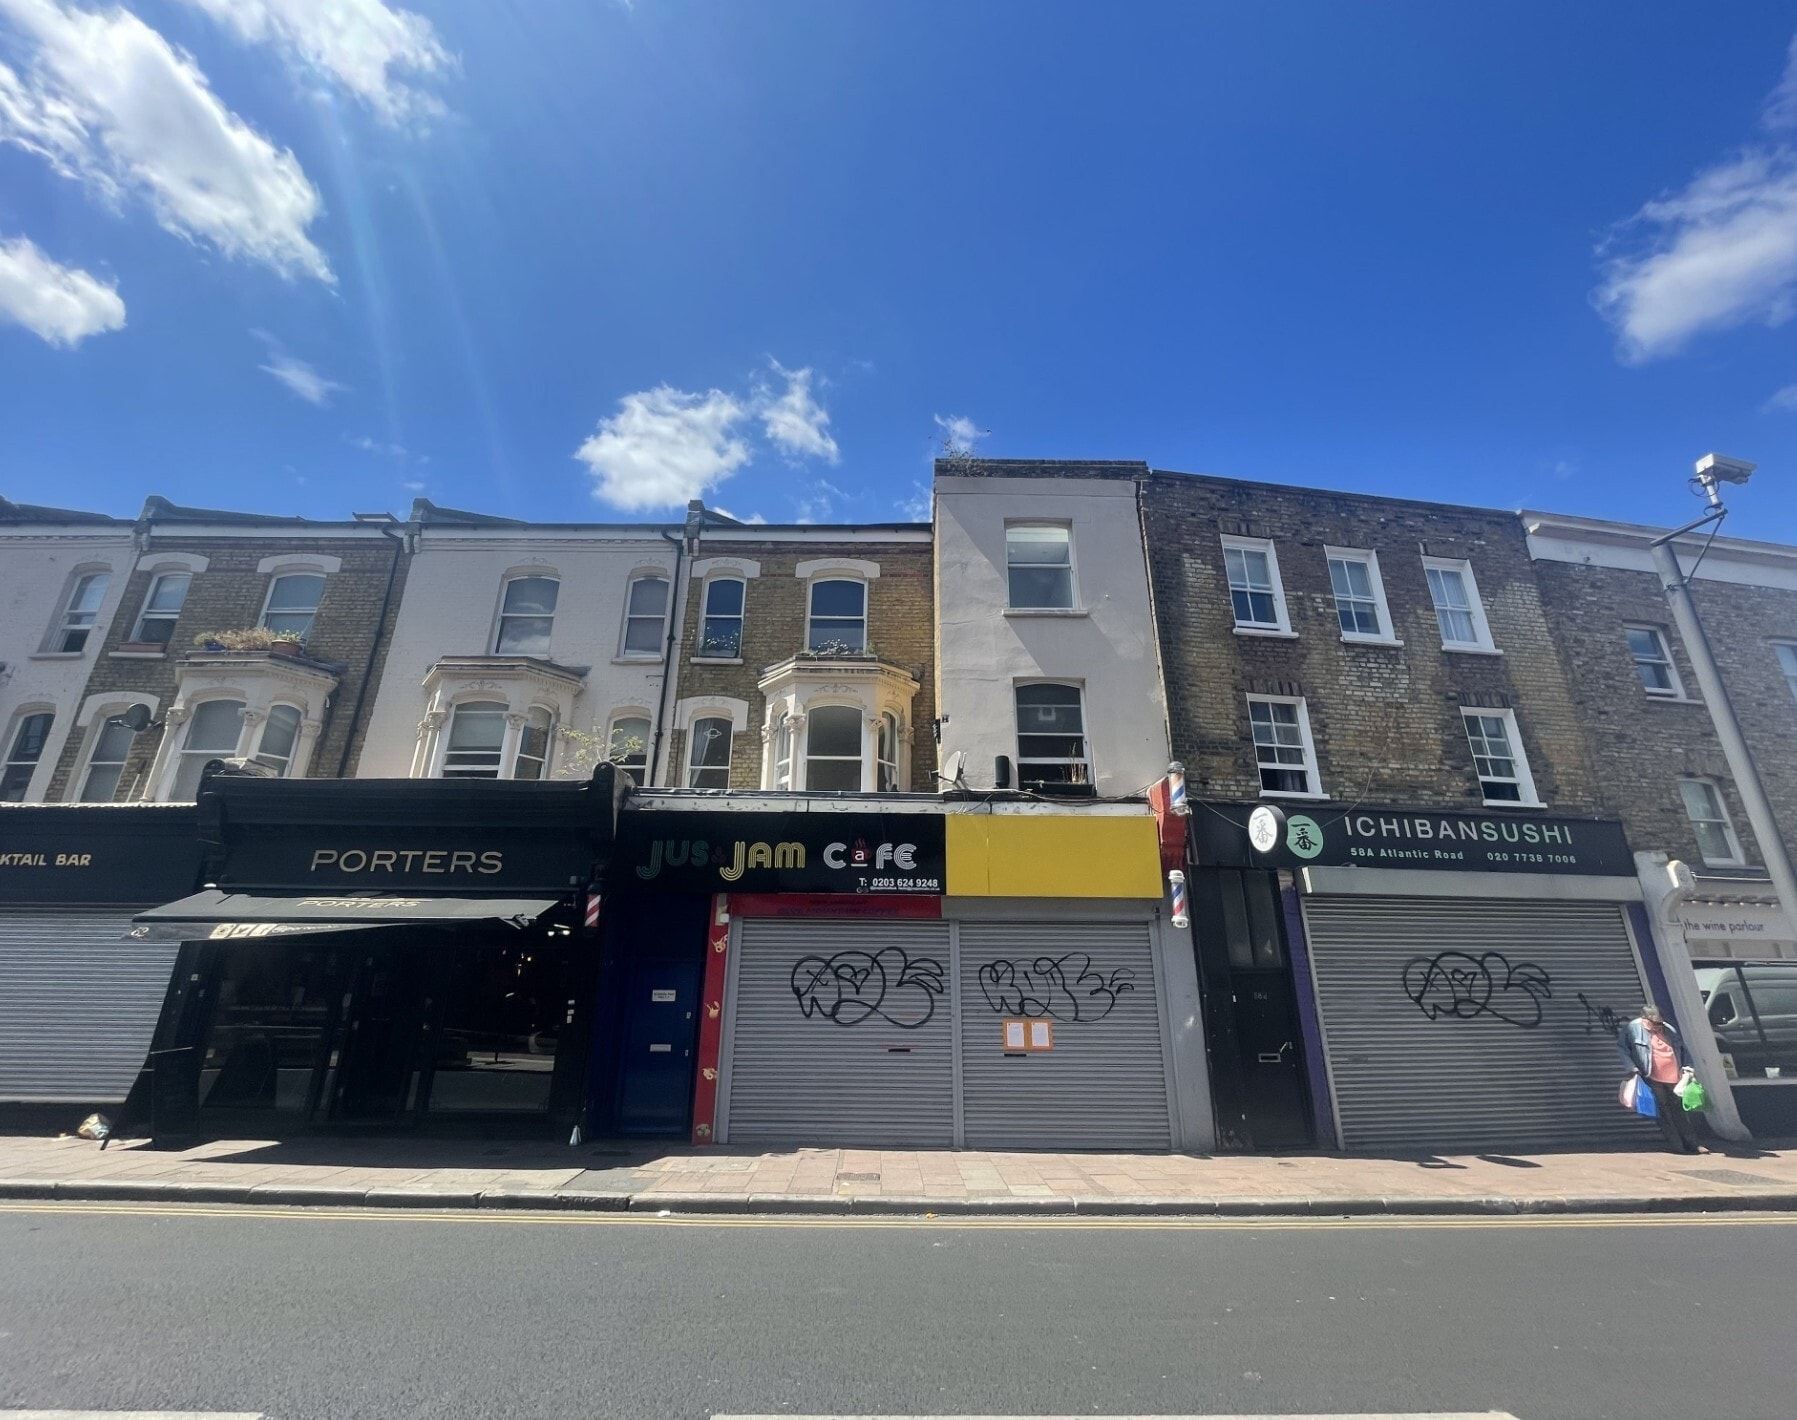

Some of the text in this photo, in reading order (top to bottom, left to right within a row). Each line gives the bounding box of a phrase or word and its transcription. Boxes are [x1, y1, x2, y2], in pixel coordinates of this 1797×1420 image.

[1291, 823, 1318, 851] 一番
[1344, 815, 1573, 845] ICHIBANSUSHI
[55, 854, 92, 866] BAR
[636, 840, 710, 880] JUS
[719, 841, 806, 881] JAM
[1350, 847, 1464, 860] 58A Atlantic Road
[1487, 852, 1576, 864] 020 7738 7006
[310, 850, 503, 874] PORTERS
[859, 877, 938, 887] T: 0203 624 9248
[296, 900, 420, 908] PORTERS
[1684, 918, 1765, 934] the wine parlour
